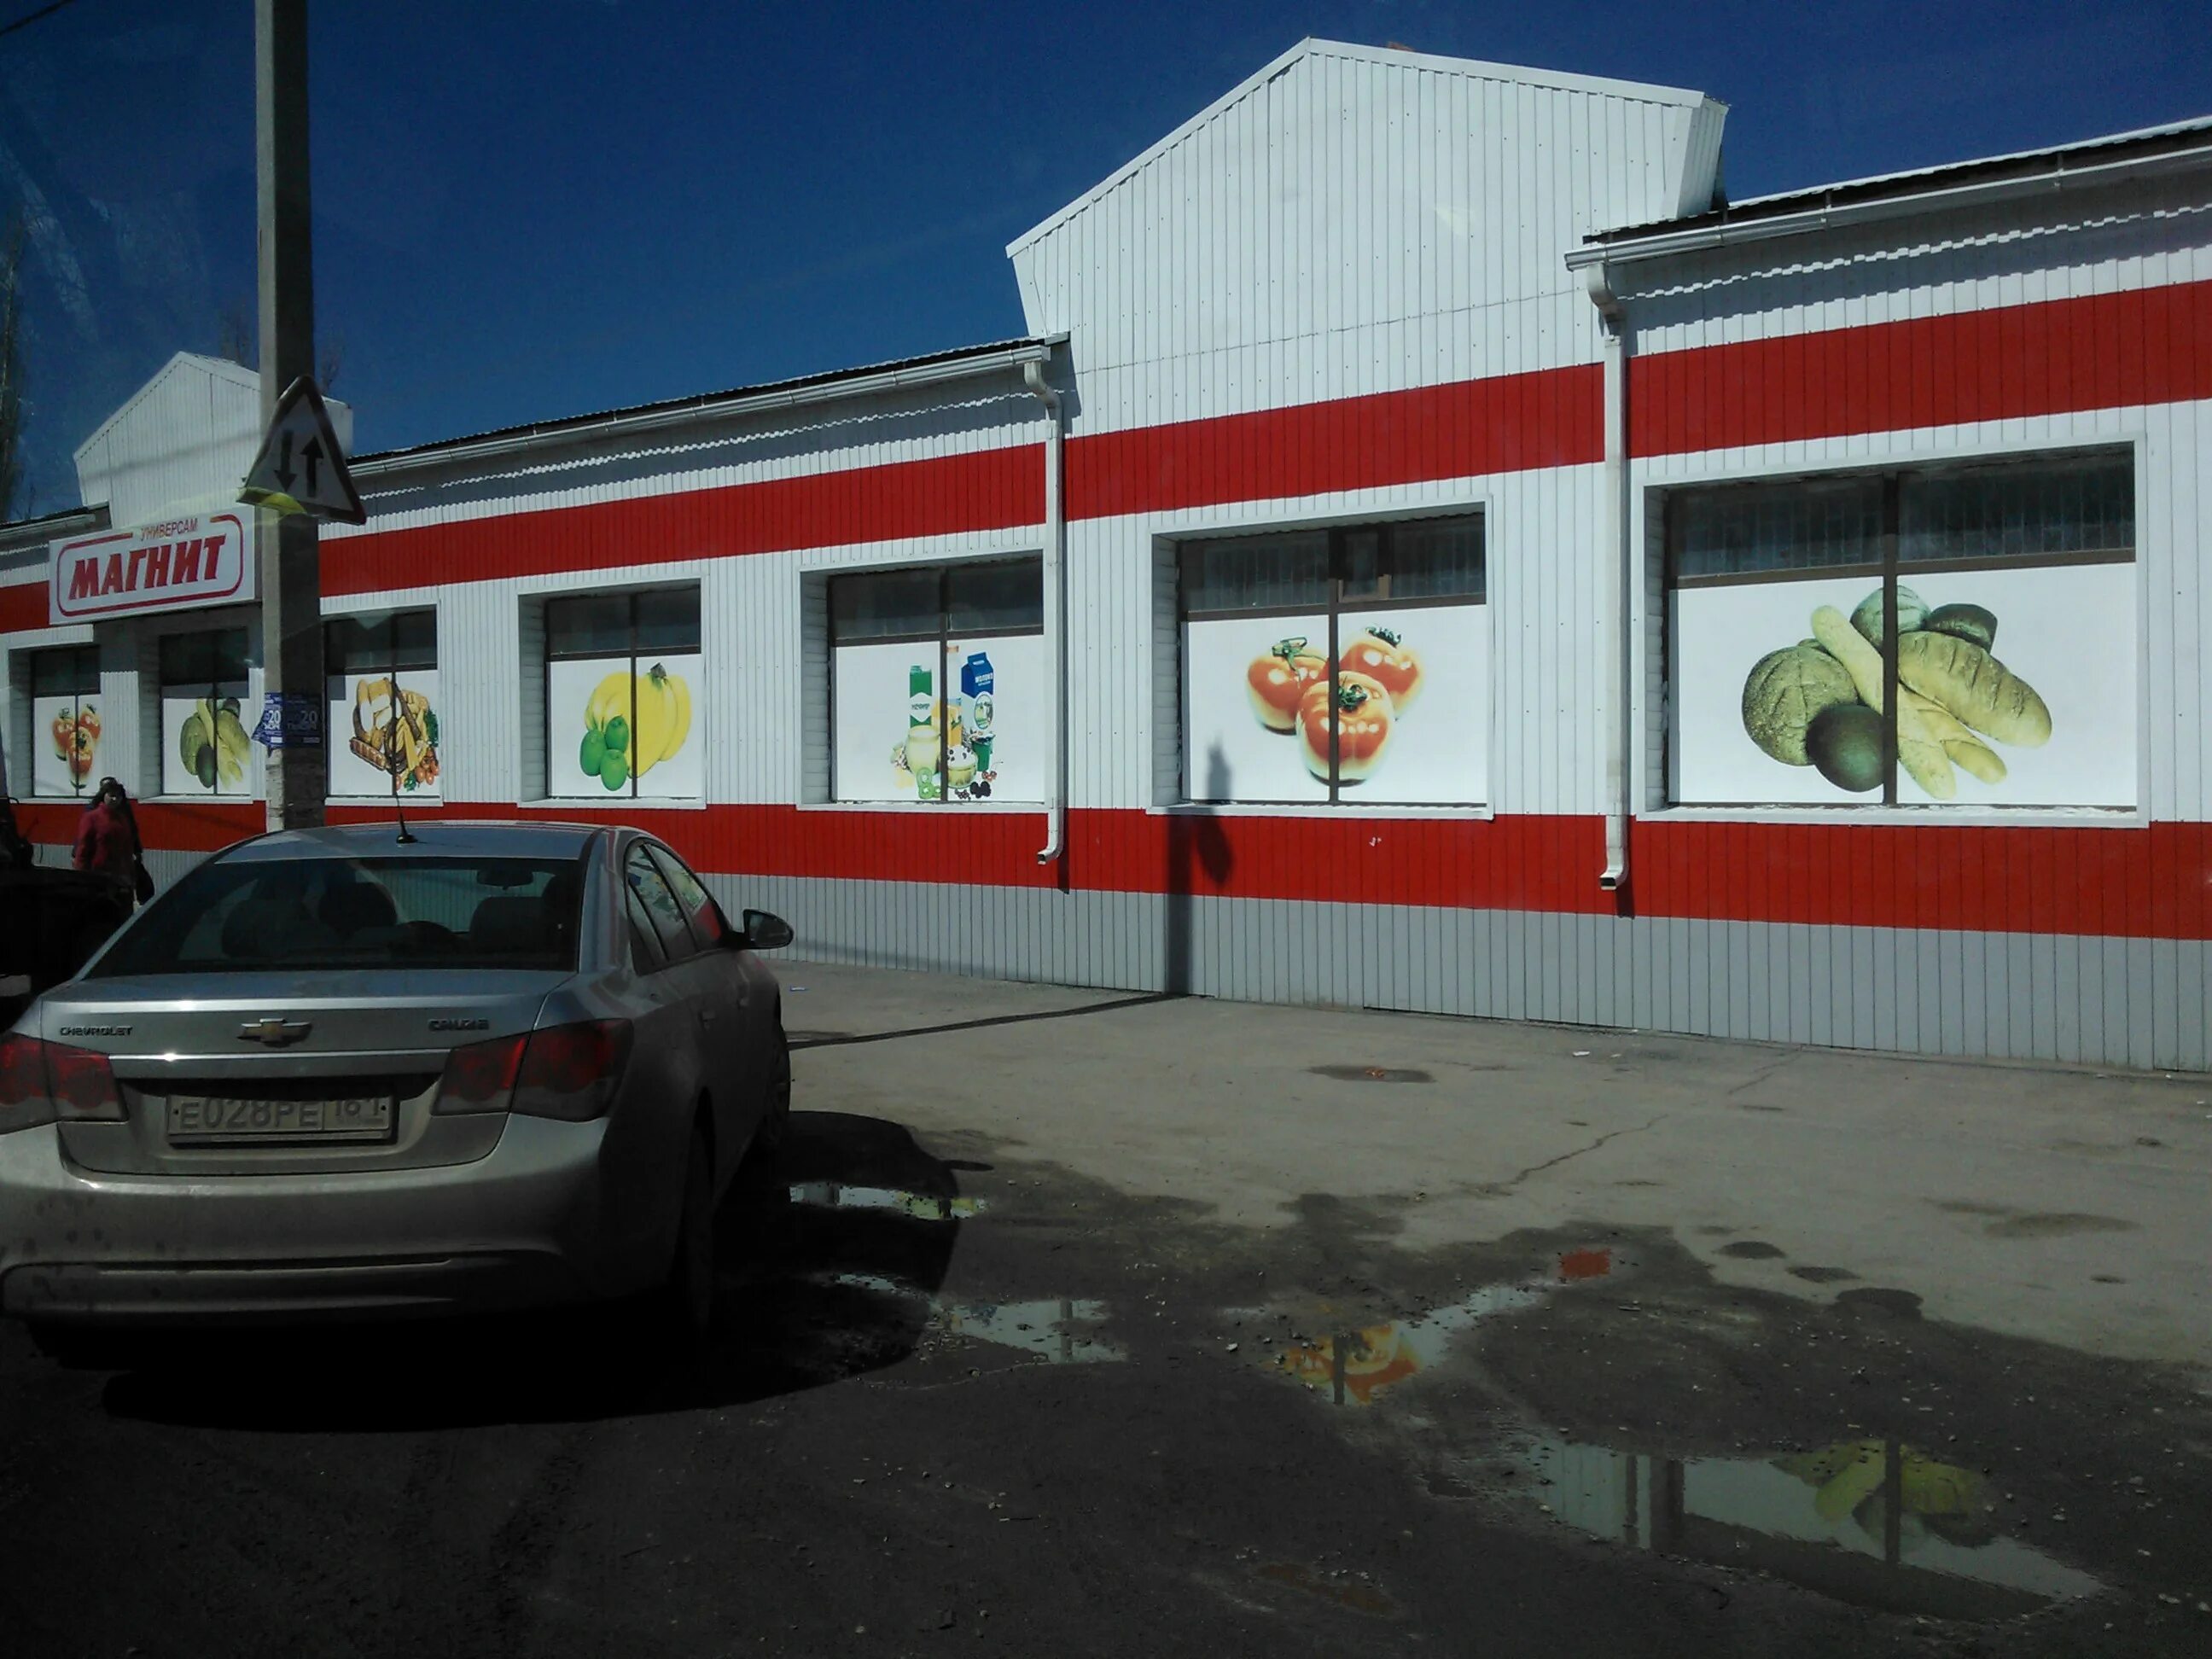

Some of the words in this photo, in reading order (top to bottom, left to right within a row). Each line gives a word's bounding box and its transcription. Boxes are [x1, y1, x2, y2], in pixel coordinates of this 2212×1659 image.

[141, 517, 198, 541] УНИВЕРСАМ
[68, 533, 226, 600] МАГНИТ
[60, 1027, 133, 1036] CHEVROLET
